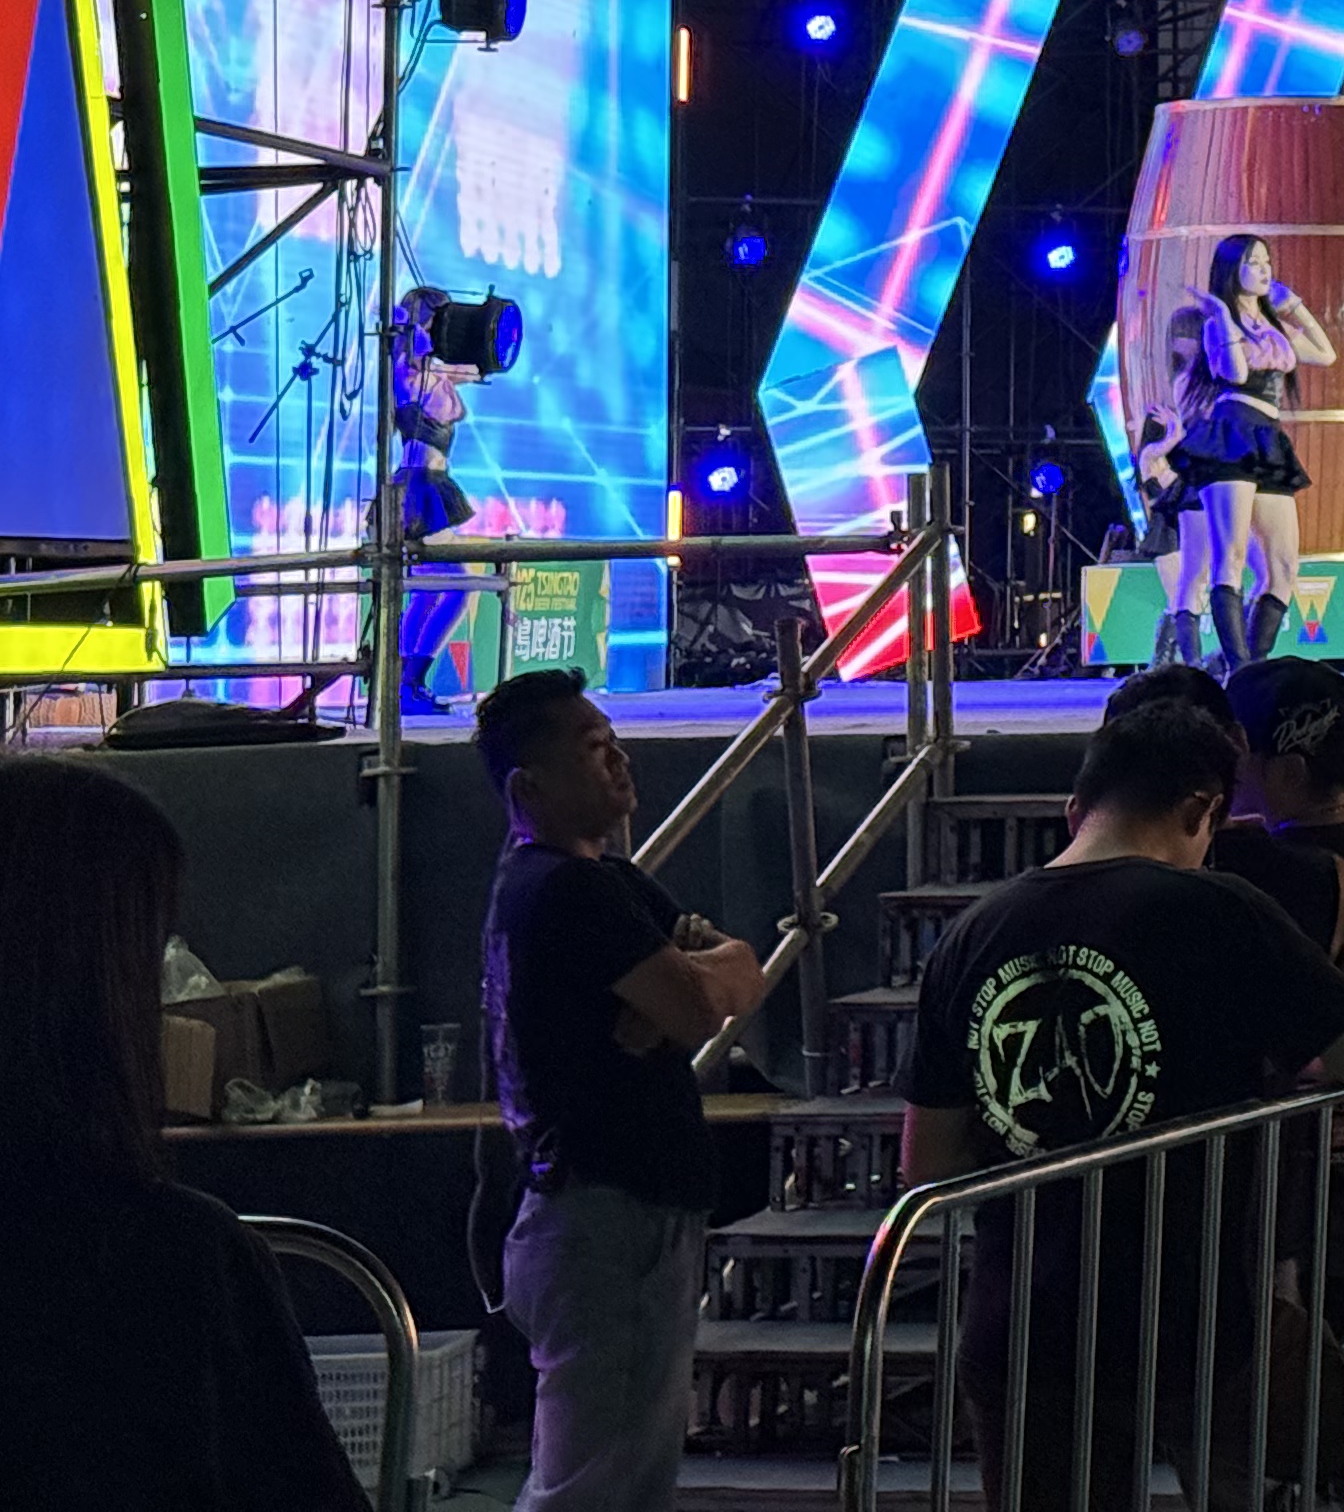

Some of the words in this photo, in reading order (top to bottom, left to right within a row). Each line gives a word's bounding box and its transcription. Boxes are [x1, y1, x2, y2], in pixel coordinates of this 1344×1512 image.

[971, 977, 998, 1019] STOP
[1075, 946, 1116, 977] STOP
[1109, 970, 1151, 1020] MUSIC
[1137, 1018, 1163, 1055] NOT
